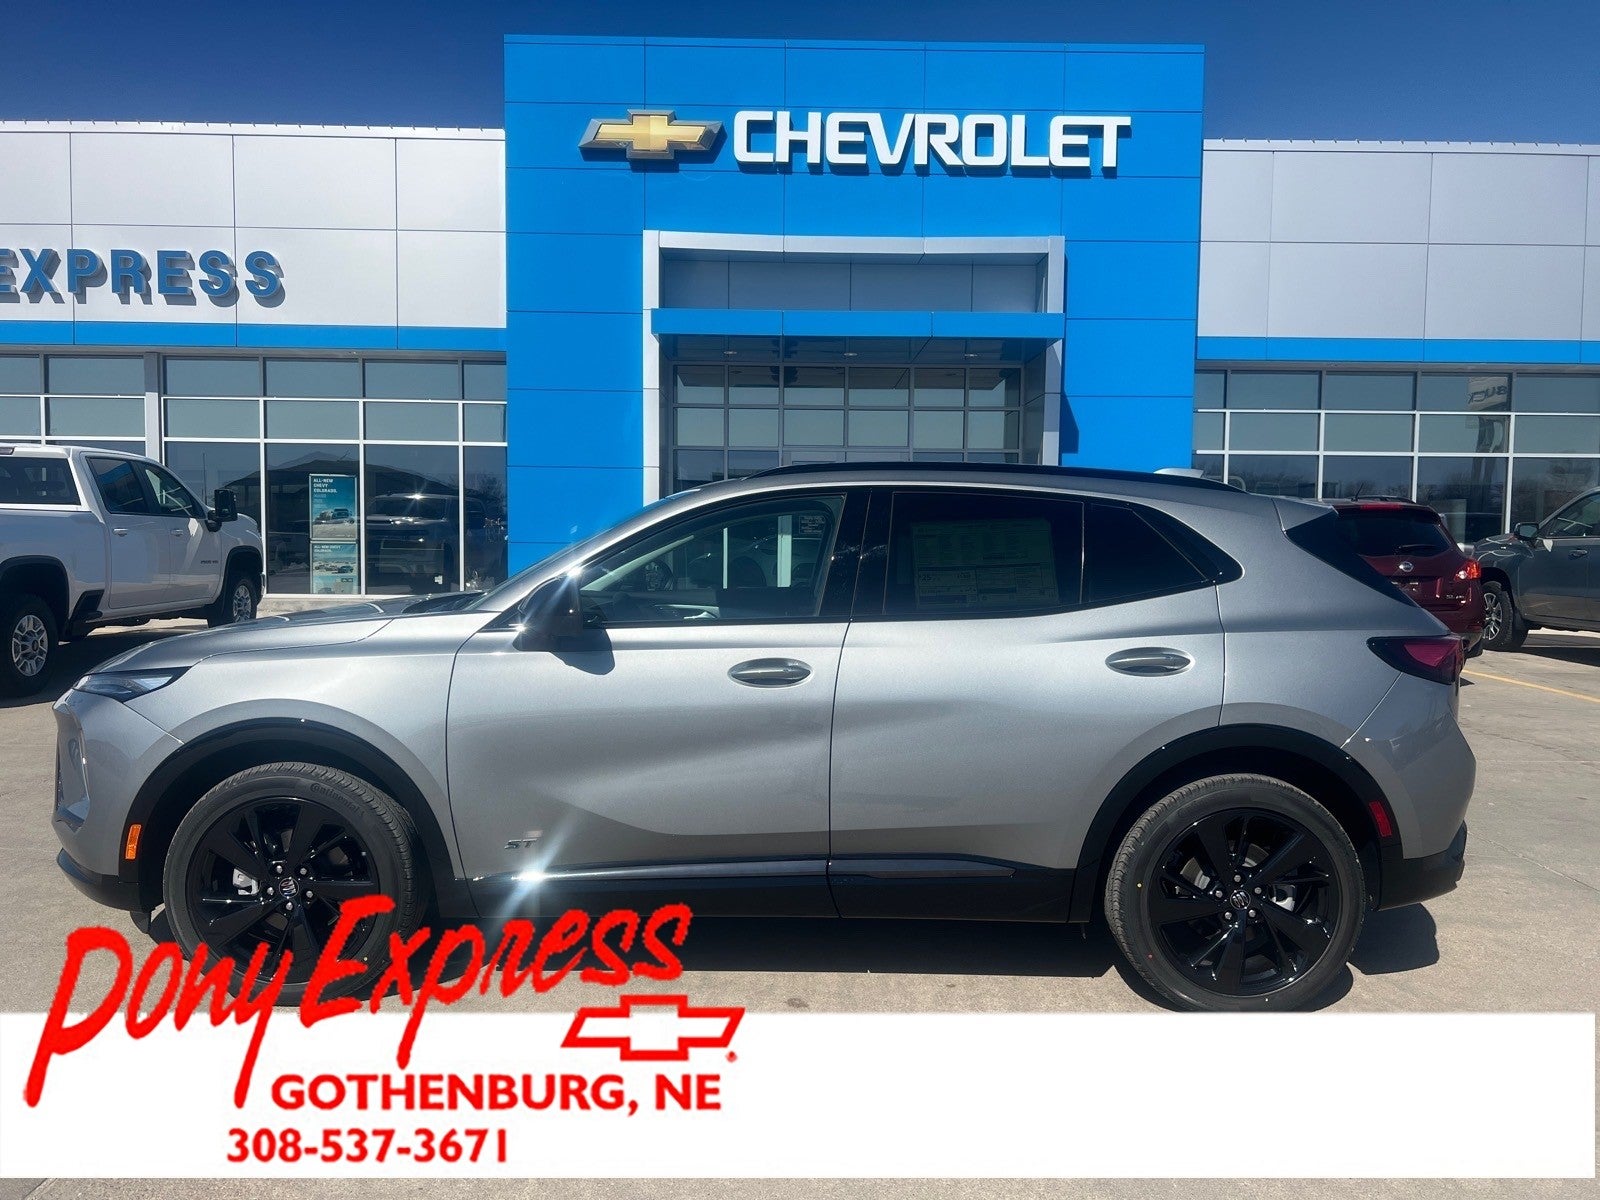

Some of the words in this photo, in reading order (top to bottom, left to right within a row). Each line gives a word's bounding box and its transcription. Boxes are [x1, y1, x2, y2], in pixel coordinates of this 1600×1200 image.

[733, 110, 1131, 168] CHEVROLET
[0, 248, 281, 302] EXPRESS
[504, 838, 537, 849] ST
